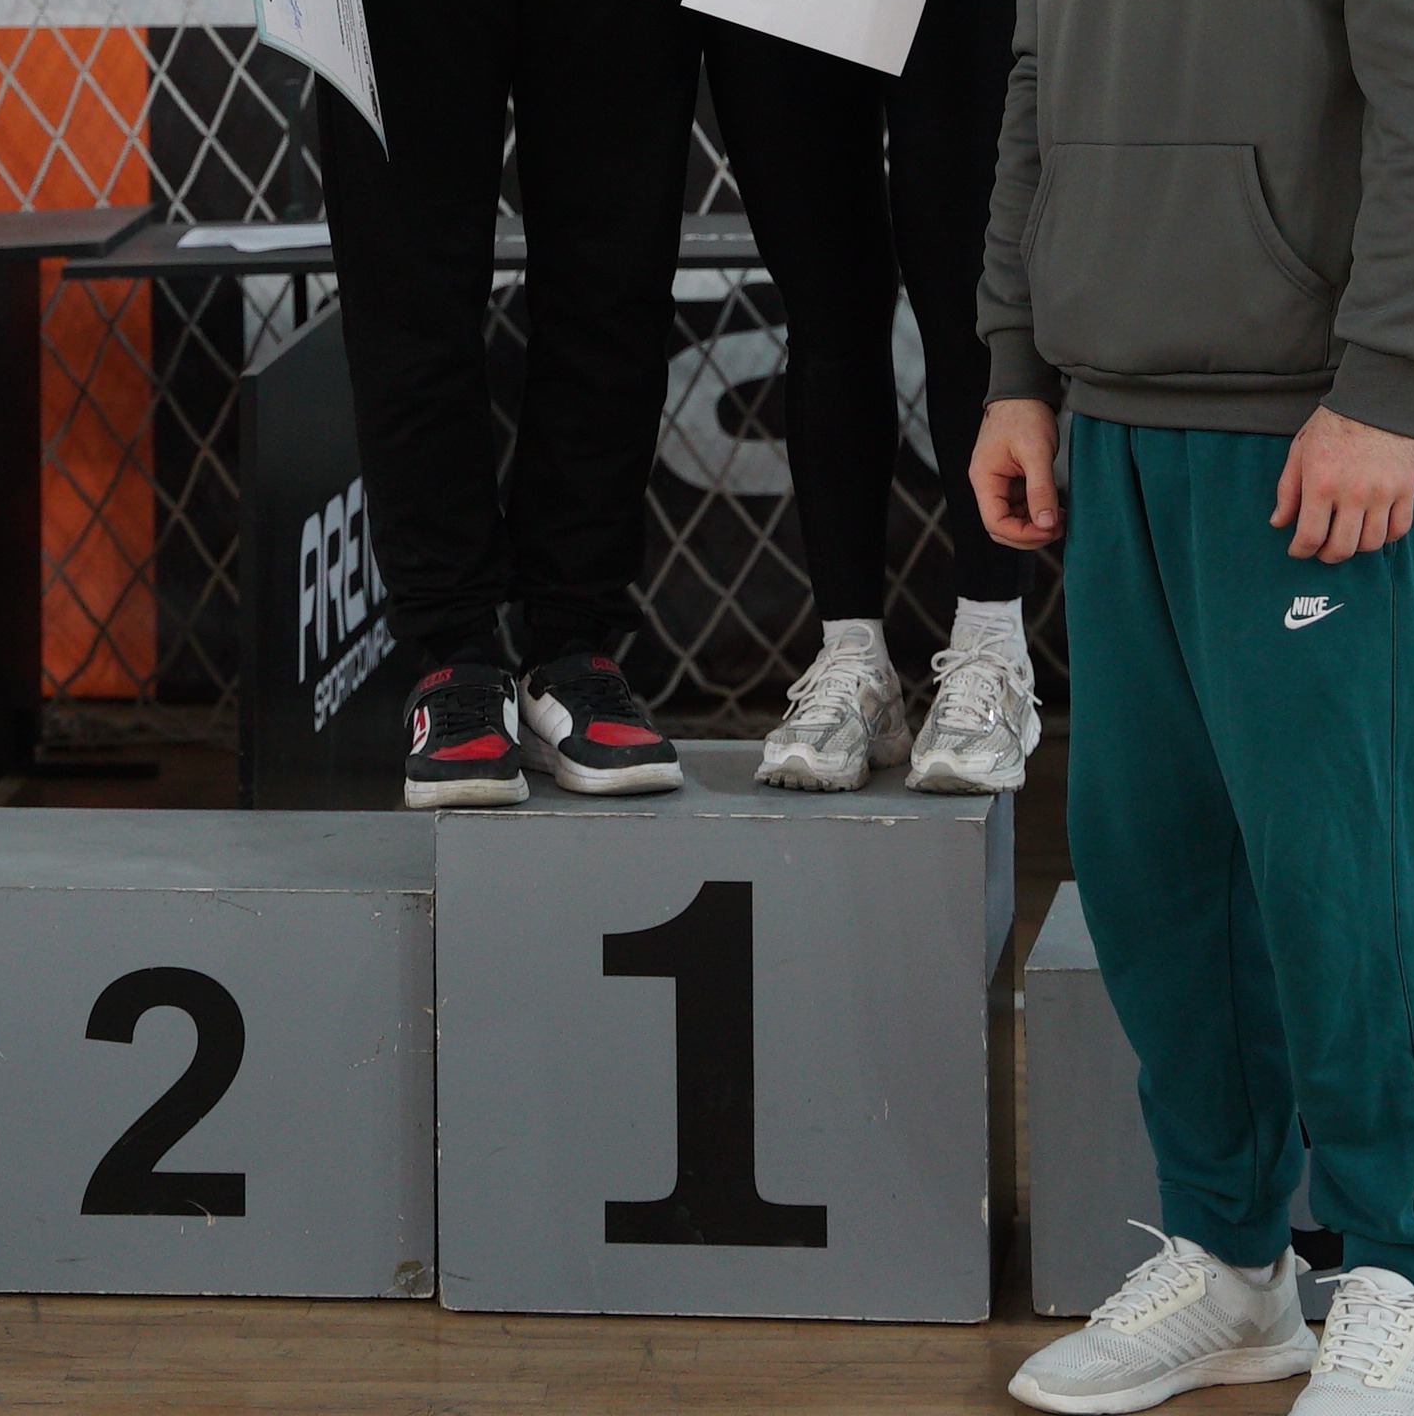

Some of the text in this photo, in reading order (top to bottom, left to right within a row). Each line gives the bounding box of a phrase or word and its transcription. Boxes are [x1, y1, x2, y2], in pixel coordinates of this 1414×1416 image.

[1291, 596, 1330, 616] NIKE
[81, 967, 245, 1216] 2
[603, 881, 827, 1248] 1
